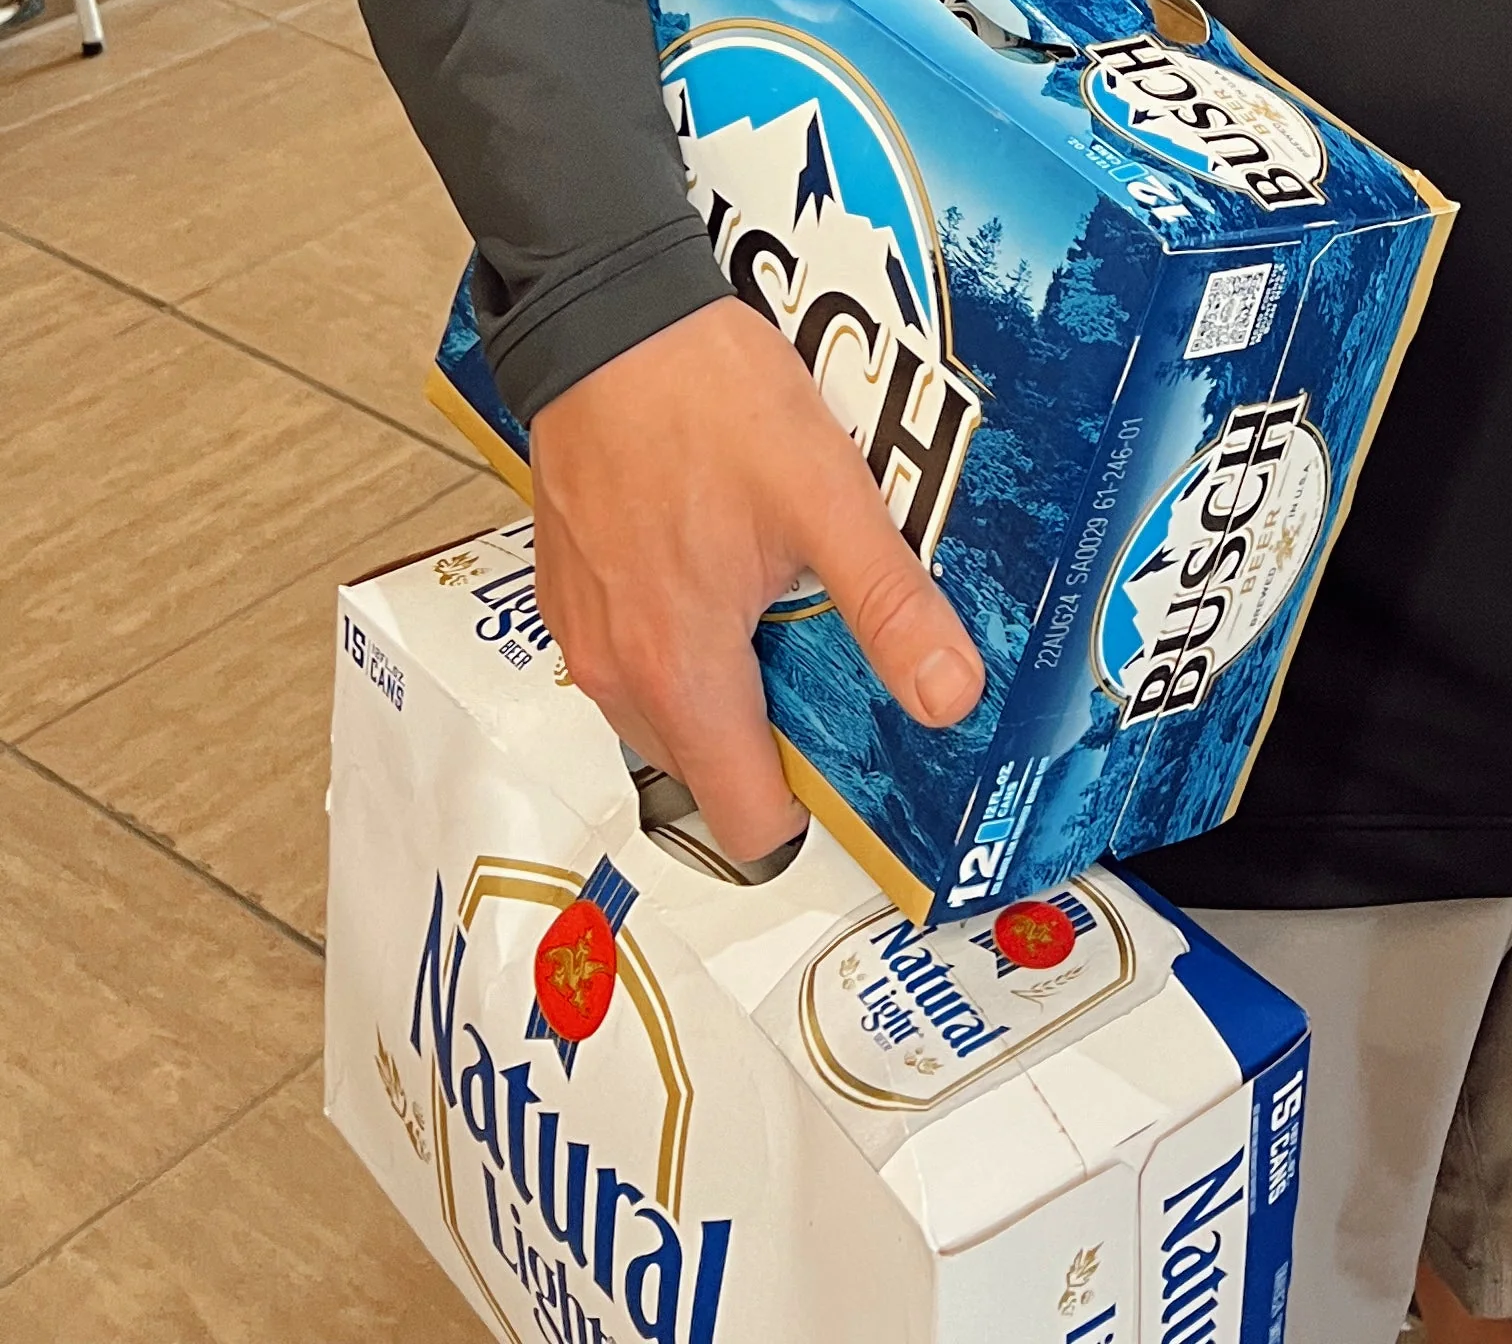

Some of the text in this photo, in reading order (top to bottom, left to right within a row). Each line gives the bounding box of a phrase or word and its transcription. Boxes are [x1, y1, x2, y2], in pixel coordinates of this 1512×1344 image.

[1093, 38, 1318, 206] BUSCH
[1210, 87, 1273, 136] BEER
[1126, 175, 1193, 224] 12
[700, 182, 974, 562] SCH
[1035, 416, 1144, 670] 22AUG24 SA0029 61-246-01
[1126, 401, 1303, 723] BUSCH
[1239, 506, 1282, 597] BEER
[470, 565, 555, 652] Lig
[1250, 566, 1278, 628] BREWED
[343, 613, 367, 669] 15
[498, 638, 533, 671] BEER
[369, 657, 405, 712] CANS
[996, 780, 1020, 818] CANS
[946, 838, 1007, 909] 12
[857, 975, 925, 1045] Light
[869, 917, 1012, 1059] Natural
[409, 868, 733, 1344] Natural
[1270, 1067, 1304, 1133] 15
[1267, 1135, 1290, 1206] CANS
